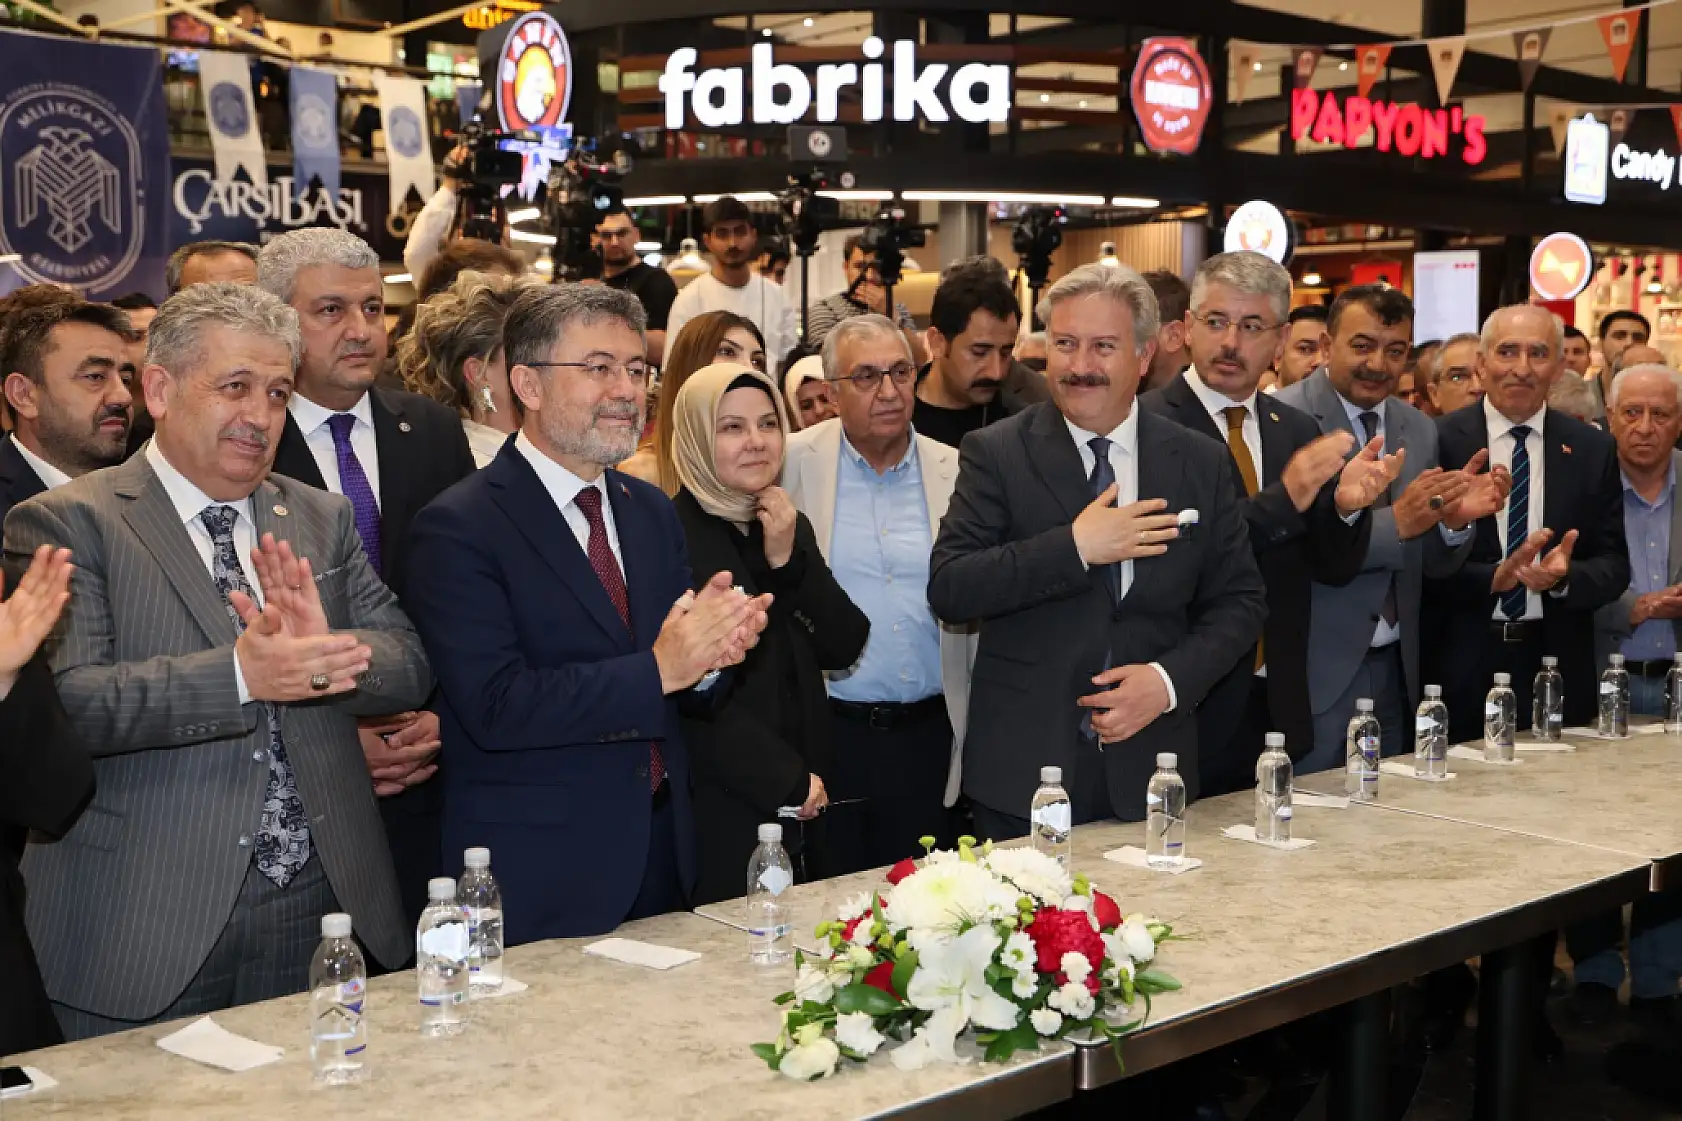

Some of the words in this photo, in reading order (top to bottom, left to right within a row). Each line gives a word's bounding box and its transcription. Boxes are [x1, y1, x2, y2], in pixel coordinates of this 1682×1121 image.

[658, 36, 1011, 129] fabrika
[1291, 88, 1487, 165] PAPYON'S
[1611, 142, 1675, 190] Candy
